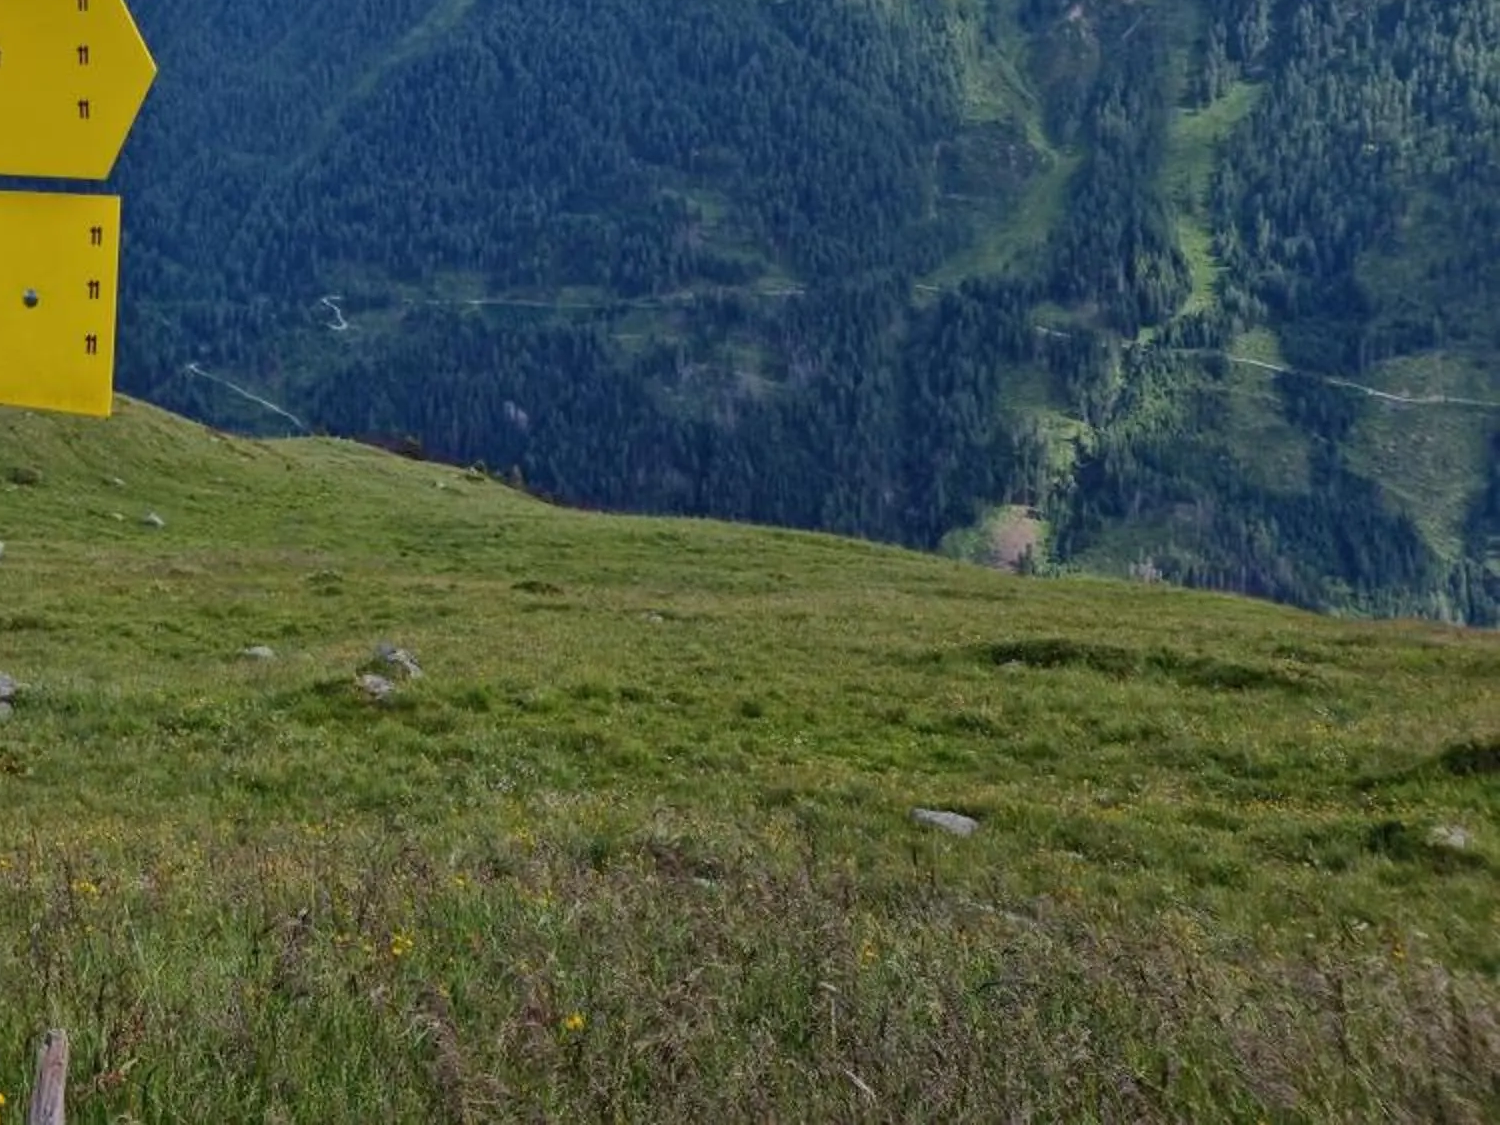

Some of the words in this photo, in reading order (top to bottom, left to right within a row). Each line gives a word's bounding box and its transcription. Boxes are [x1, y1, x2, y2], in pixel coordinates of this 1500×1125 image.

[77, 46, 89, 65] 11
[77, 99, 90, 119] 11
[90, 226, 102, 246] 11
[87, 280, 100, 299] 11
[85, 334, 97, 355] 11
